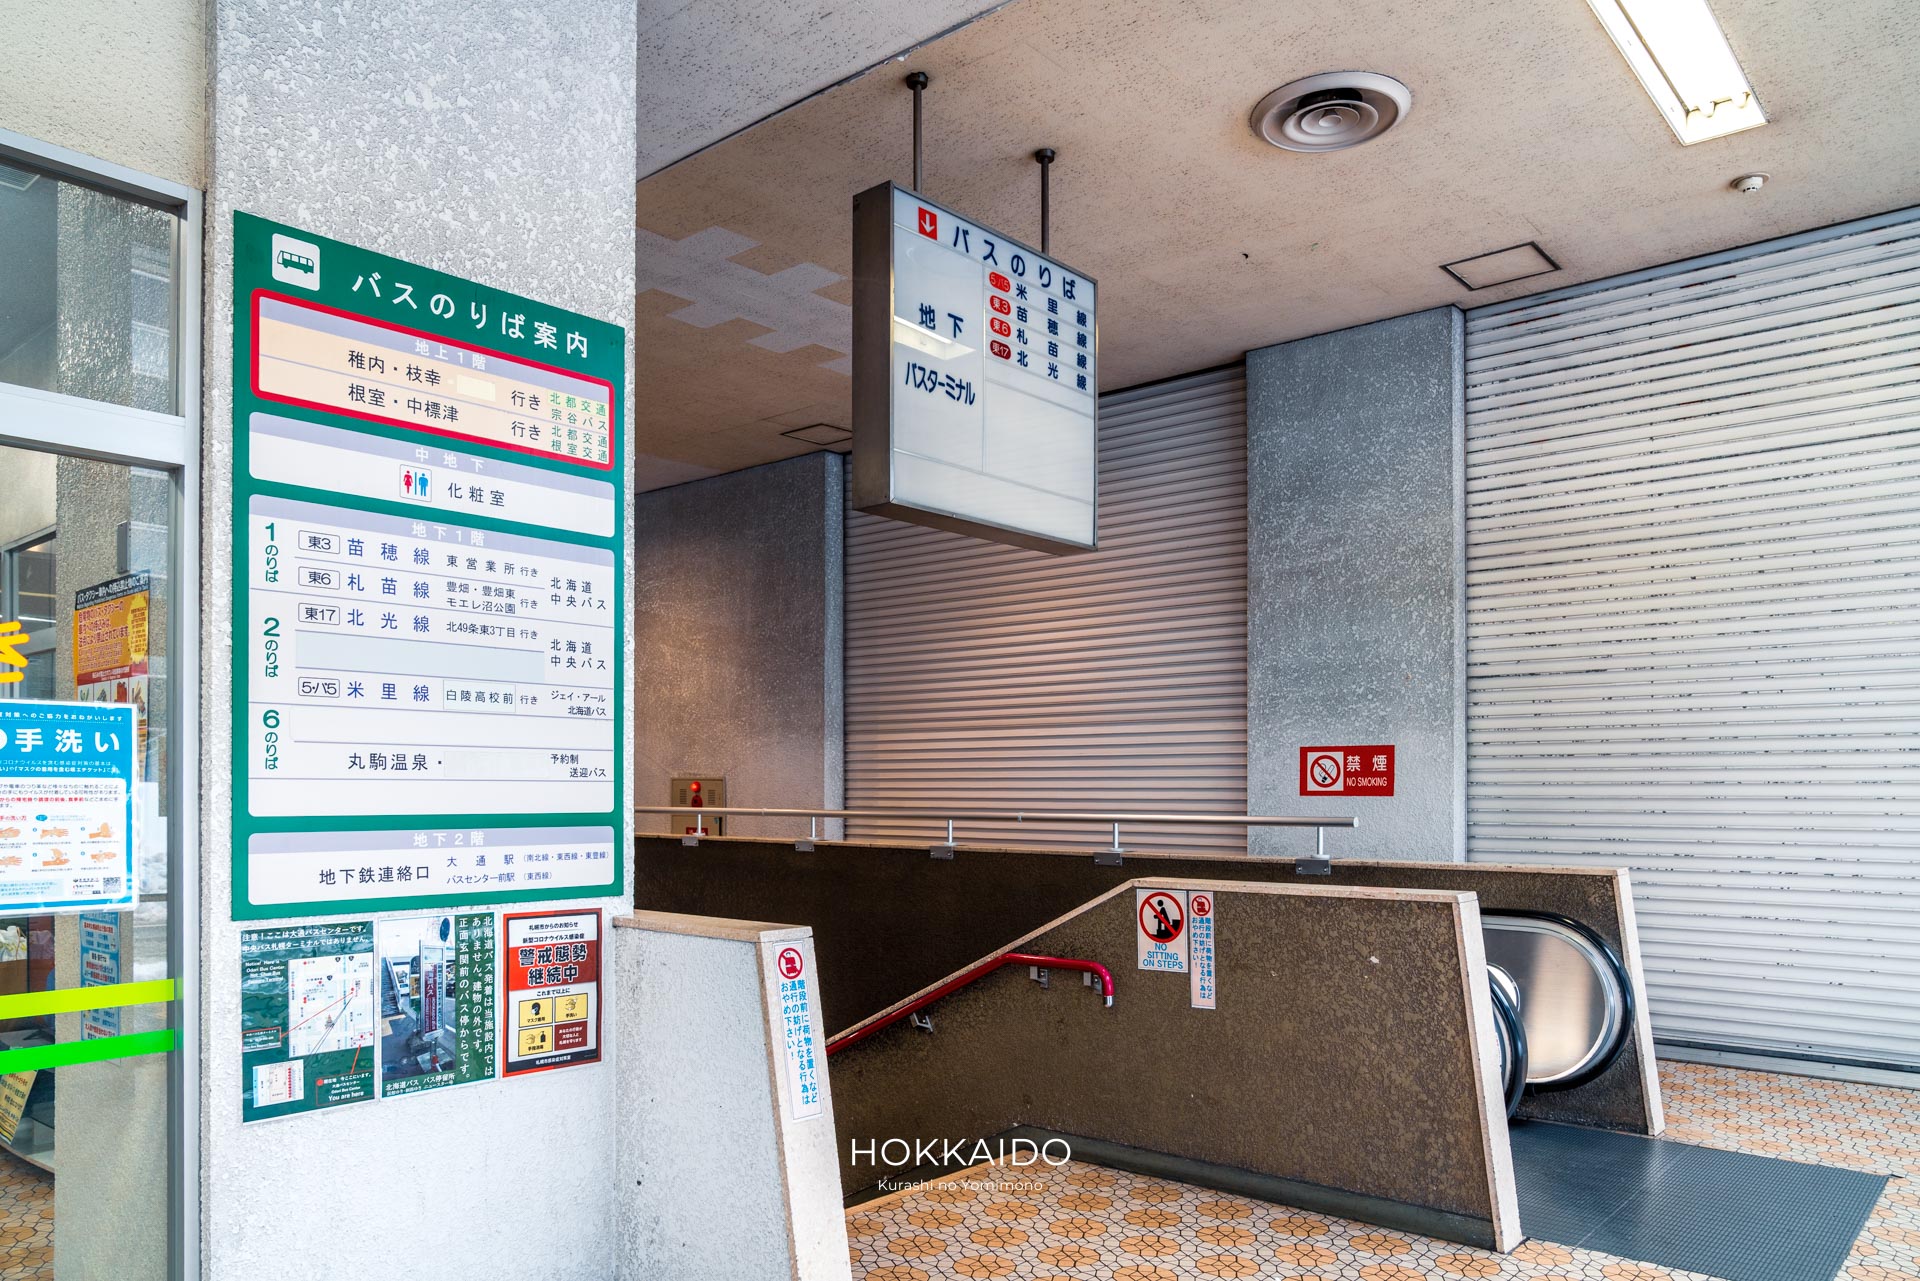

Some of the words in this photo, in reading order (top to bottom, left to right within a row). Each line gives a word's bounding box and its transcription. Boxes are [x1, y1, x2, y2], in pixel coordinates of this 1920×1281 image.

[953, 226, 1077, 300] バスのりば
[352, 272, 589, 359] バスのりば案内
[1016, 283, 1088, 328] 米里線
[918, 302, 964, 339] 地下
[992, 297, 1008, 312] 東3
[1016, 306, 1088, 349] 苗穂線
[414, 338, 487, 371] 地上1階
[992, 319, 1009, 335] 東6
[1016, 328, 1088, 370] 札苗線
[992, 342, 1009, 358] 東17
[1017, 350, 1088, 391] 北光線
[347, 349, 442, 387] 稚内・枝幸
[511, 389, 541, 411] 行き
[550, 392, 607, 417] 北都交通
[905, 362, 976, 406] バスターミナル
[347, 382, 460, 423] 根室・中標津
[511, 420, 541, 442] 行き
[551, 425, 608, 449] 北都交通
[551, 408, 608, 432] 宗谷バス
[415, 447, 486, 473] 中地下
[551, 438, 608, 463] 根室交通
[447, 481, 506, 508] 化粧室
[411, 521, 486, 548] 地下1階
[308, 534, 333, 551] 東3
[347, 538, 431, 566] 苗穂線
[446, 554, 516, 576] 東営業所
[520, 566, 539, 578] 行き
[308, 570, 332, 586] 東6
[347, 572, 431, 599] 札苗線
[520, 598, 539, 610] 行き
[550, 577, 593, 594] 北海道
[446, 597, 516, 615] モエレ沼公園
[550, 593, 607, 611] 中央バス
[304, 606, 336, 623] 東17
[347, 608, 431, 634] 北光線
[446, 621, 516, 639] 北49条東3丁目
[520, 628, 539, 640] 行き
[550, 638, 593, 655] 北海道
[550, 654, 607, 671] 中央バス
[347, 680, 431, 703] 米里線
[446, 689, 514, 705] 白陵高校前
[520, 694, 539, 706] 行き
[550, 690, 607, 703] ジェイ・アール
[567, 705, 607, 717] 北海道バス
[550, 753, 580, 765] 予約制
[1346, 754, 1388, 772] 禁煙
[569, 767, 607, 778] 送迎バス
[1346, 777, 1357, 787] NO
[1357, 777, 1388, 787] SMOKING
[413, 831, 486, 848] 地下2階
[446, 853, 515, 868] 大通駅
[318, 865, 431, 887] 地下鉄連絡口
[446, 872, 516, 884] バスセンター前駅
[522, 933, 585, 944] 新型コロナウイルス感染症
[528, 921, 579, 932] 札幌市からのお知らせ
[518, 943, 588, 967] 警戒態勢
[1147, 951, 1179, 961] SITTING
[1154, 943, 1168, 951] NO
[528, 964, 578, 986] 継続中
[1142, 959, 1155, 967] ON
[1157, 960, 1184, 969] STEPS
[780, 981, 796, 1060] おやめ下さい!
[789, 980, 811, 1105] 通行の妨げとなる行為は
[797, 979, 818, 1103] 階段前に荷物を置くなど
